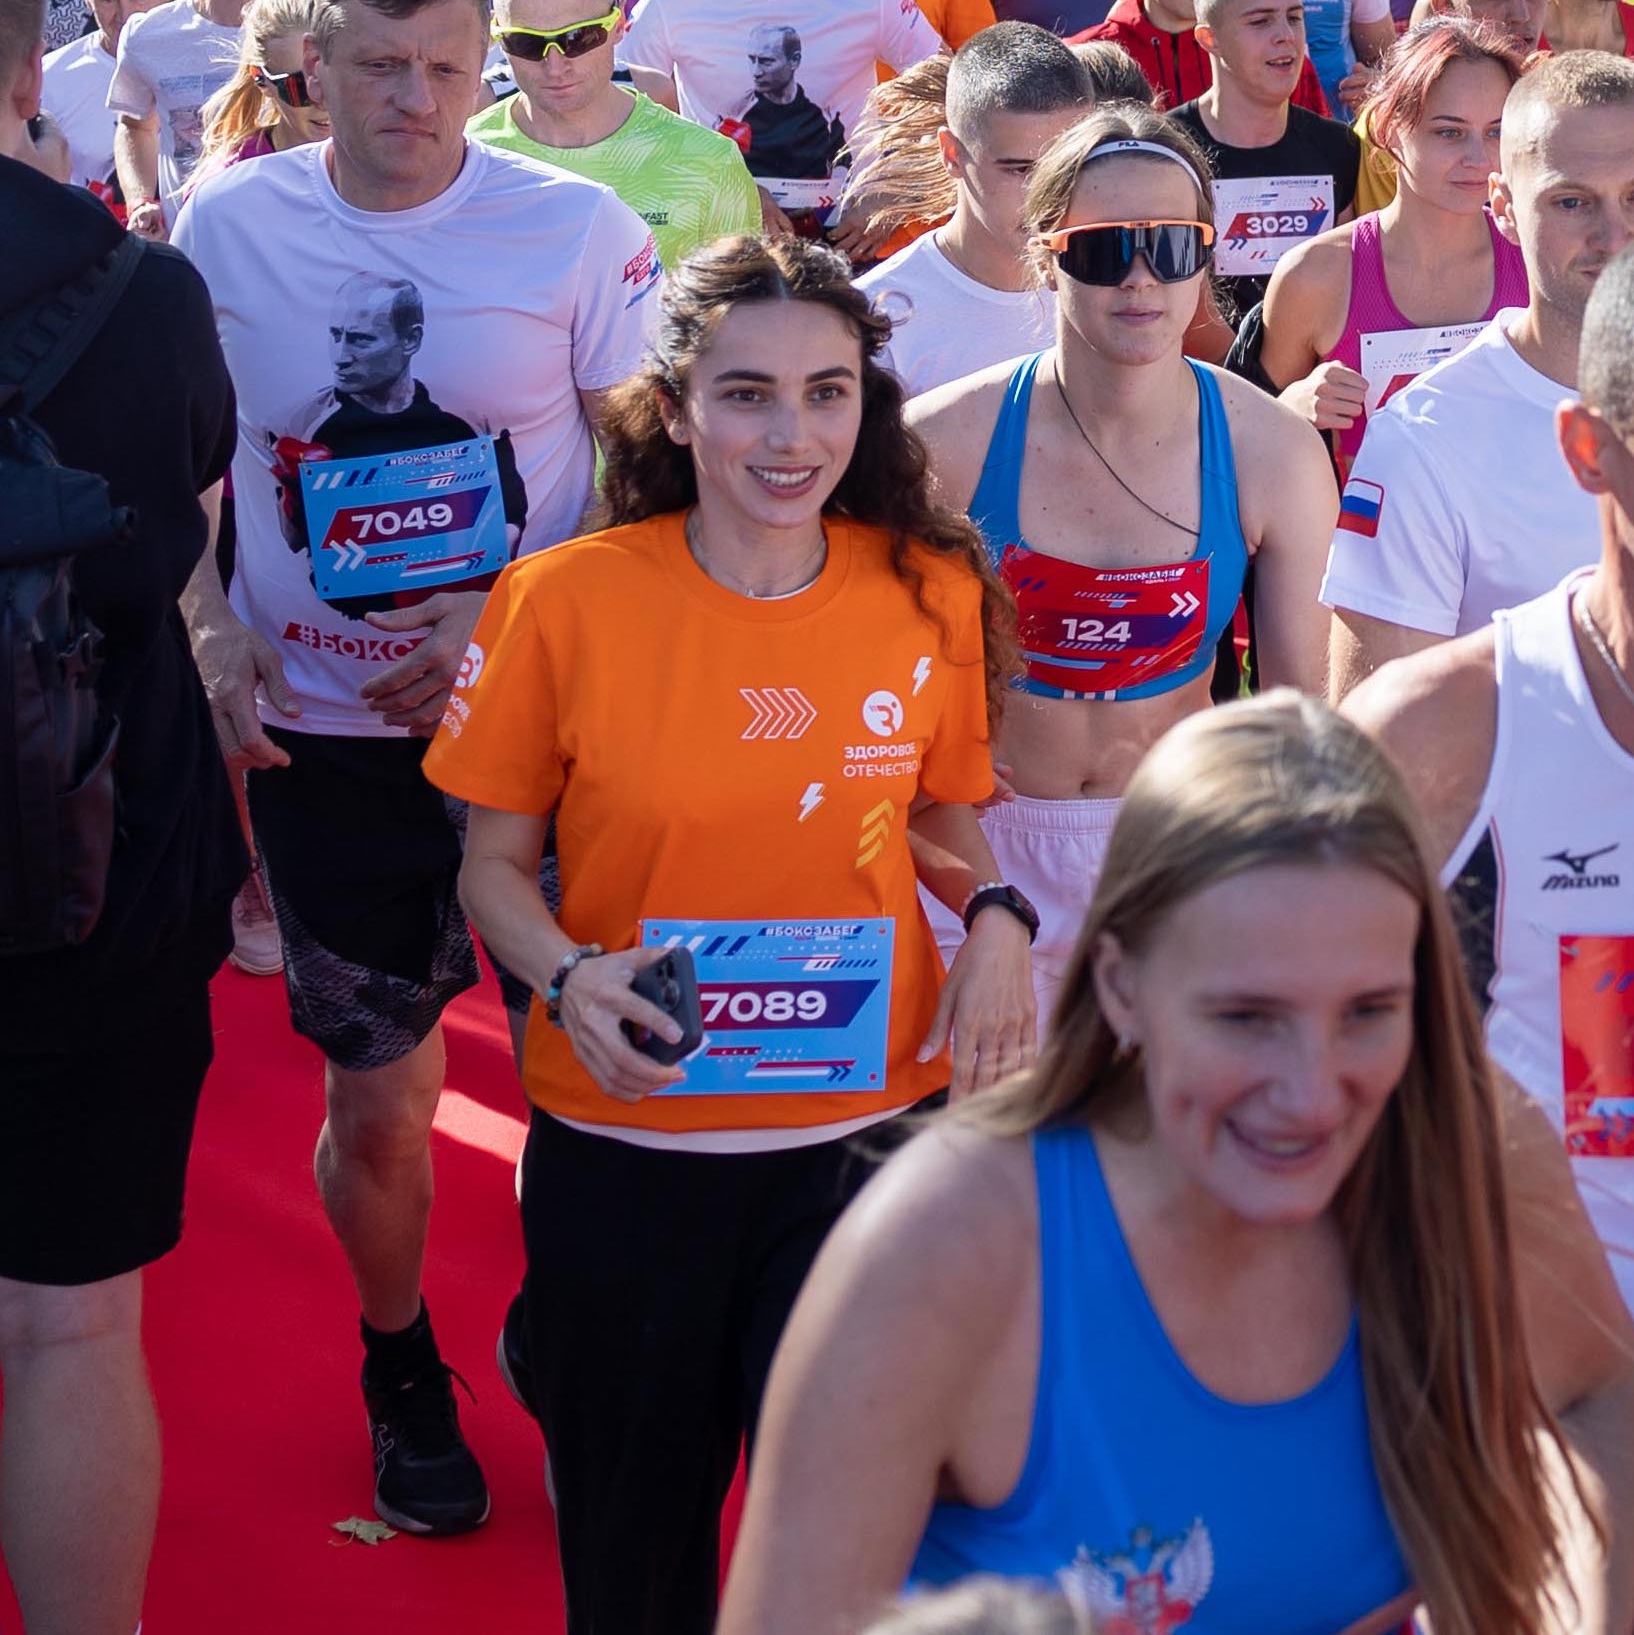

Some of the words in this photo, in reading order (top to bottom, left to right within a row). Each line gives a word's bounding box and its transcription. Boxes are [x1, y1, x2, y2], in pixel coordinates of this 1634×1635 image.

[1245, 215, 1309, 235] 3029
[389, 446, 465, 467] #БОКСЗАБЕГ
[351, 503, 453, 539] 7049
[1062, 618, 1132, 643] 124
[844, 742, 917, 761] ЗДОРОВОЕ
[843, 759, 919, 778] ОТЕЧЕСТВО
[765, 925, 857, 938] #БОКСЗАБЕГ
[700, 990, 827, 1023] 7089
